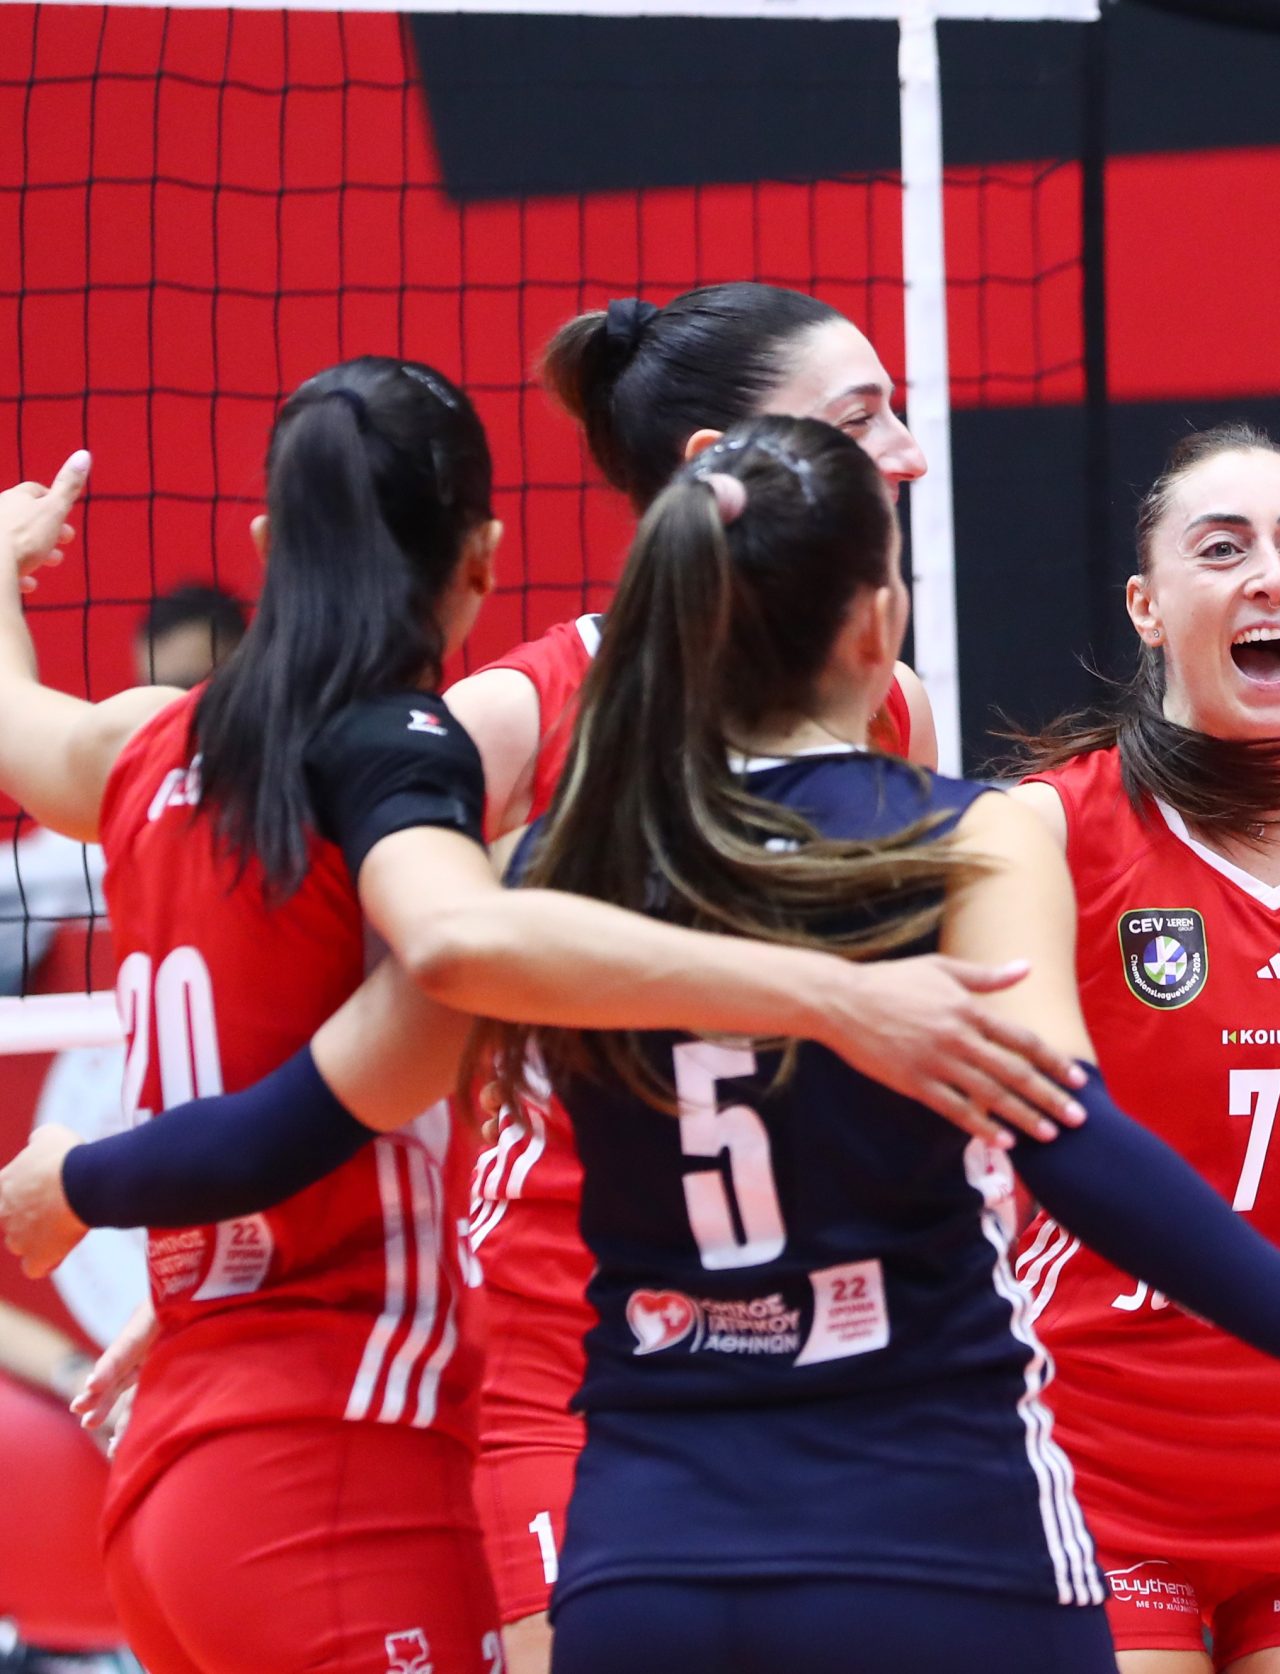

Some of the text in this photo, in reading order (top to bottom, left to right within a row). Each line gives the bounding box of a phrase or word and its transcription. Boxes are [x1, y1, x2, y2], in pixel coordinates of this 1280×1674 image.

[1128, 918, 1164, 934] CEV
[1130, 954, 1200, 1001] ChampionsLeagueVolley
[116, 946, 222, 1127] 20
[673, 1040, 787, 1270] 5
[232, 1222, 260, 1245] 22
[831, 1277, 867, 1302] 22
